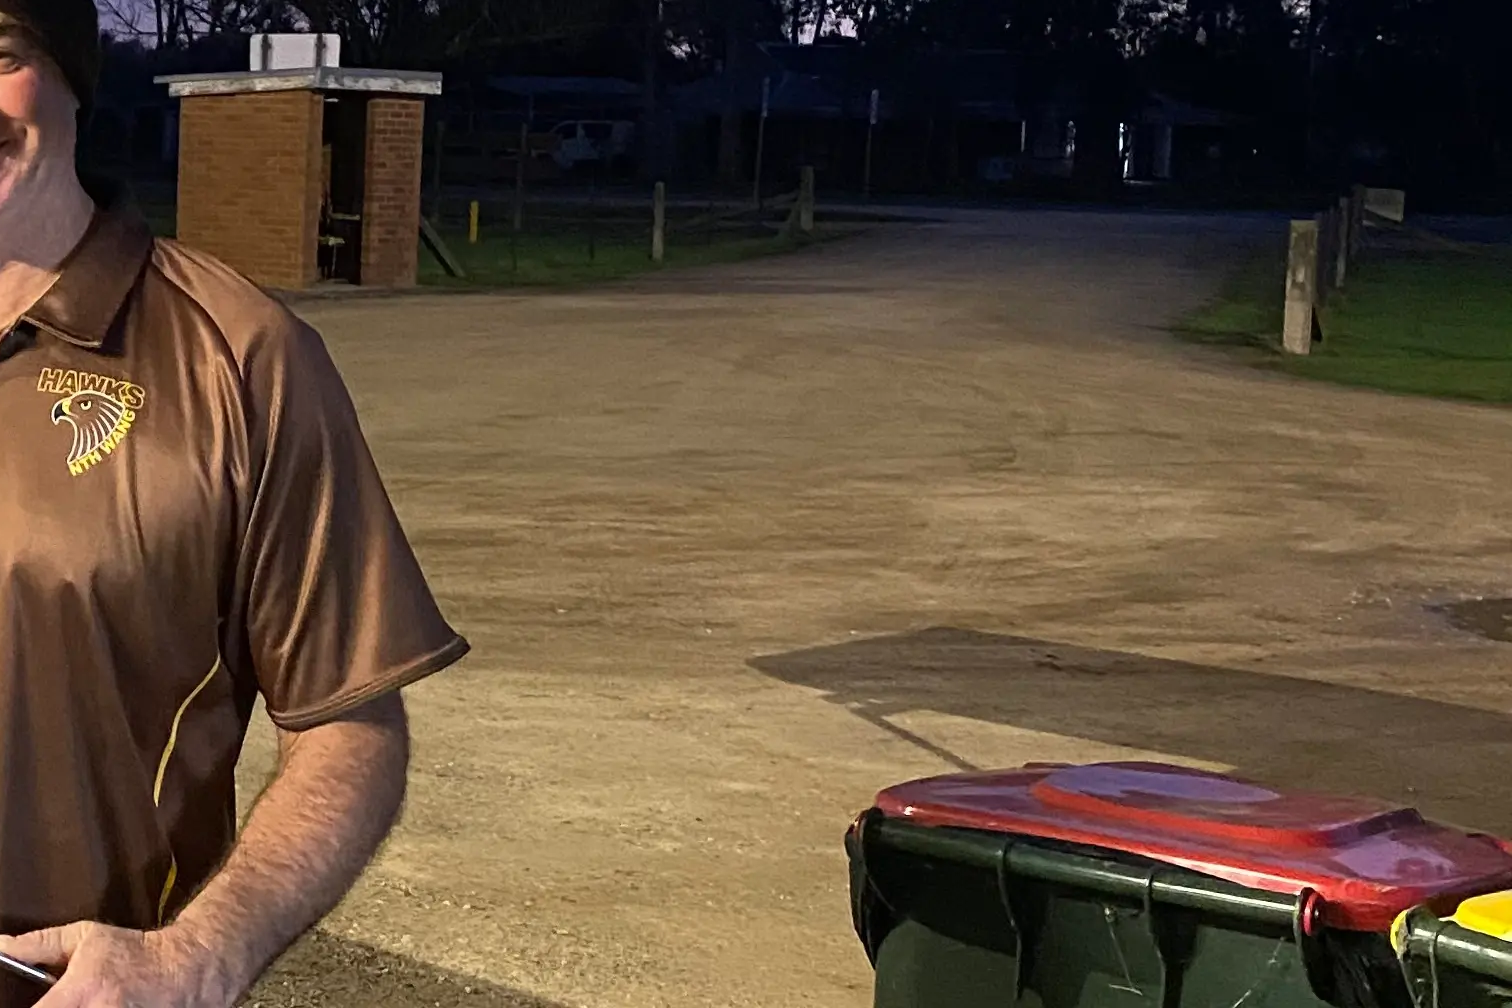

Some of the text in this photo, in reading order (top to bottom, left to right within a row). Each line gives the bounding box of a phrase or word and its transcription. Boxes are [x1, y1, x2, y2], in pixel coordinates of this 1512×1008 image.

[37, 367, 146, 410] HAWKS
[68, 409, 136, 477] NTH WANG
